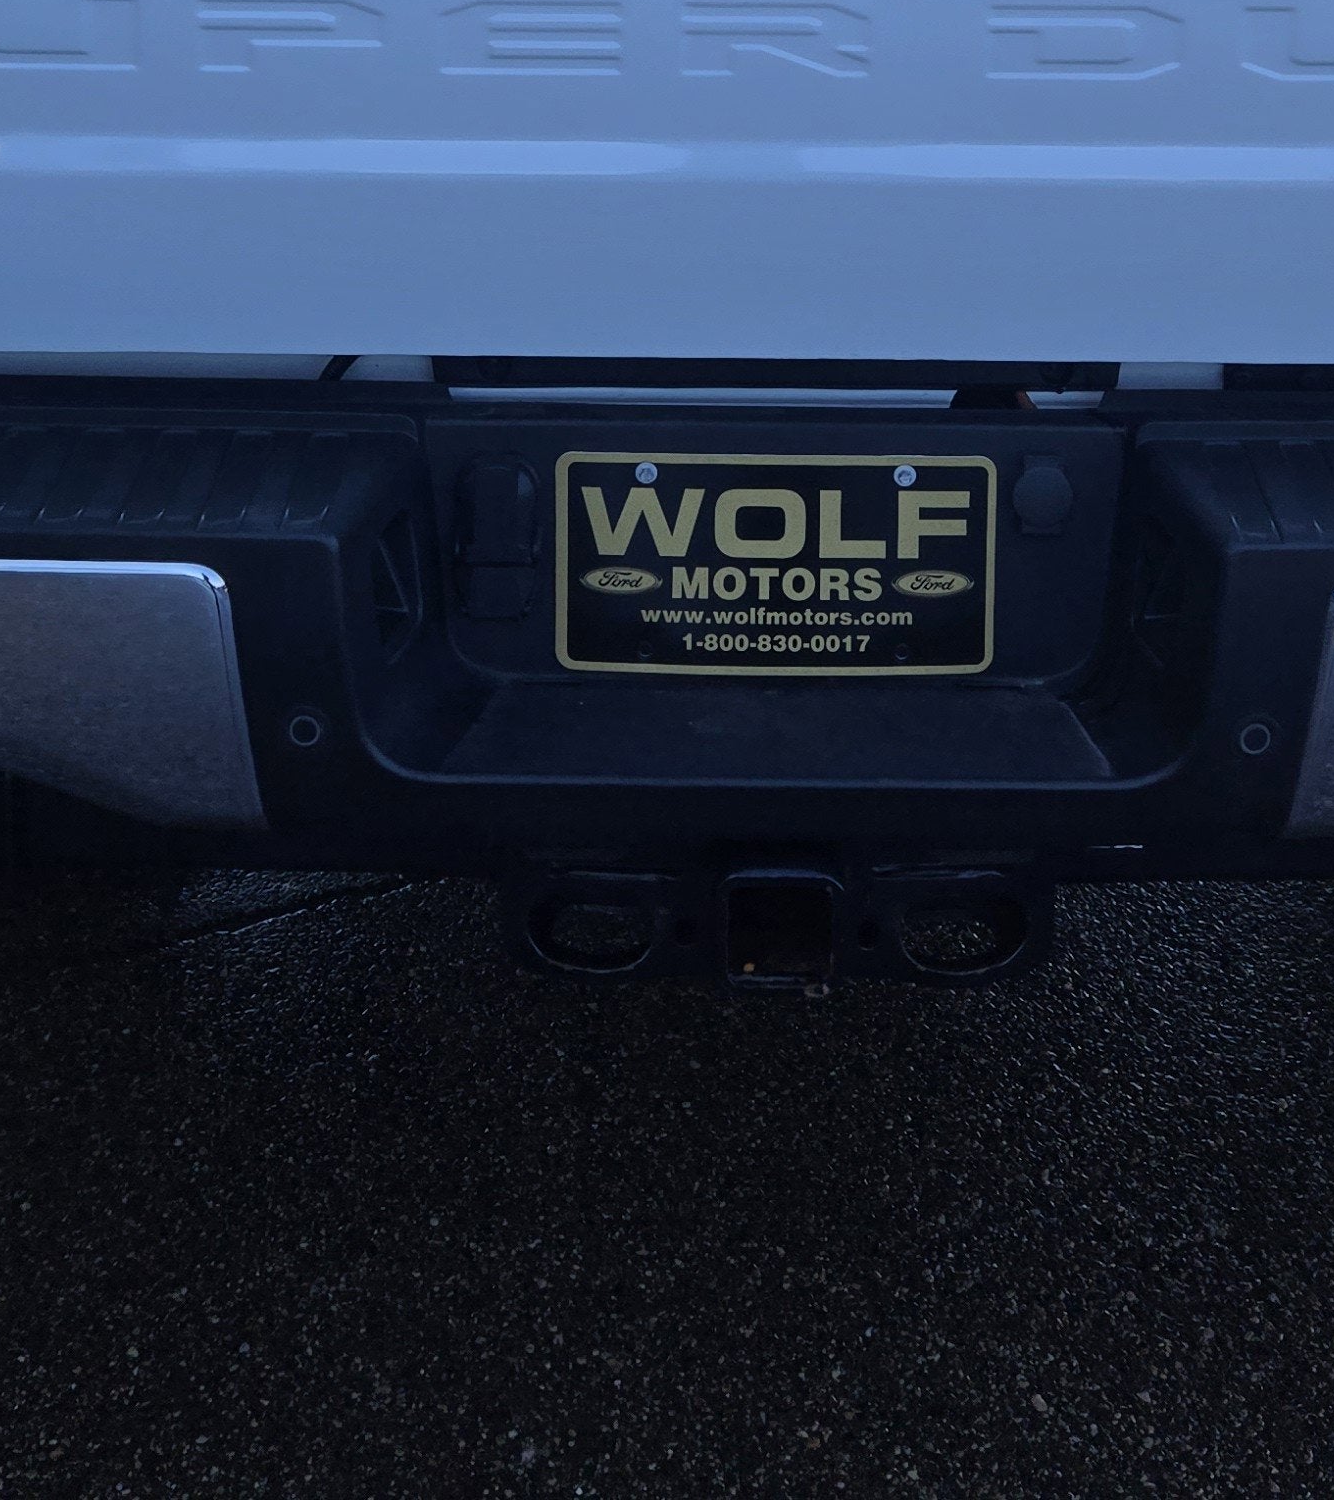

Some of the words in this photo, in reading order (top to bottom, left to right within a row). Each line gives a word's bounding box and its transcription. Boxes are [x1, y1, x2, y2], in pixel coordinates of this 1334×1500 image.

[581, 486, 970, 559] WOLF
[598, 571, 643, 588] Ford
[671, 566, 883, 602] MOTORS
[910, 574, 956, 591] Ford
[640, 607, 913, 626] www.wolfmotors.com
[682, 633, 871, 653] 1-800-830-0017
